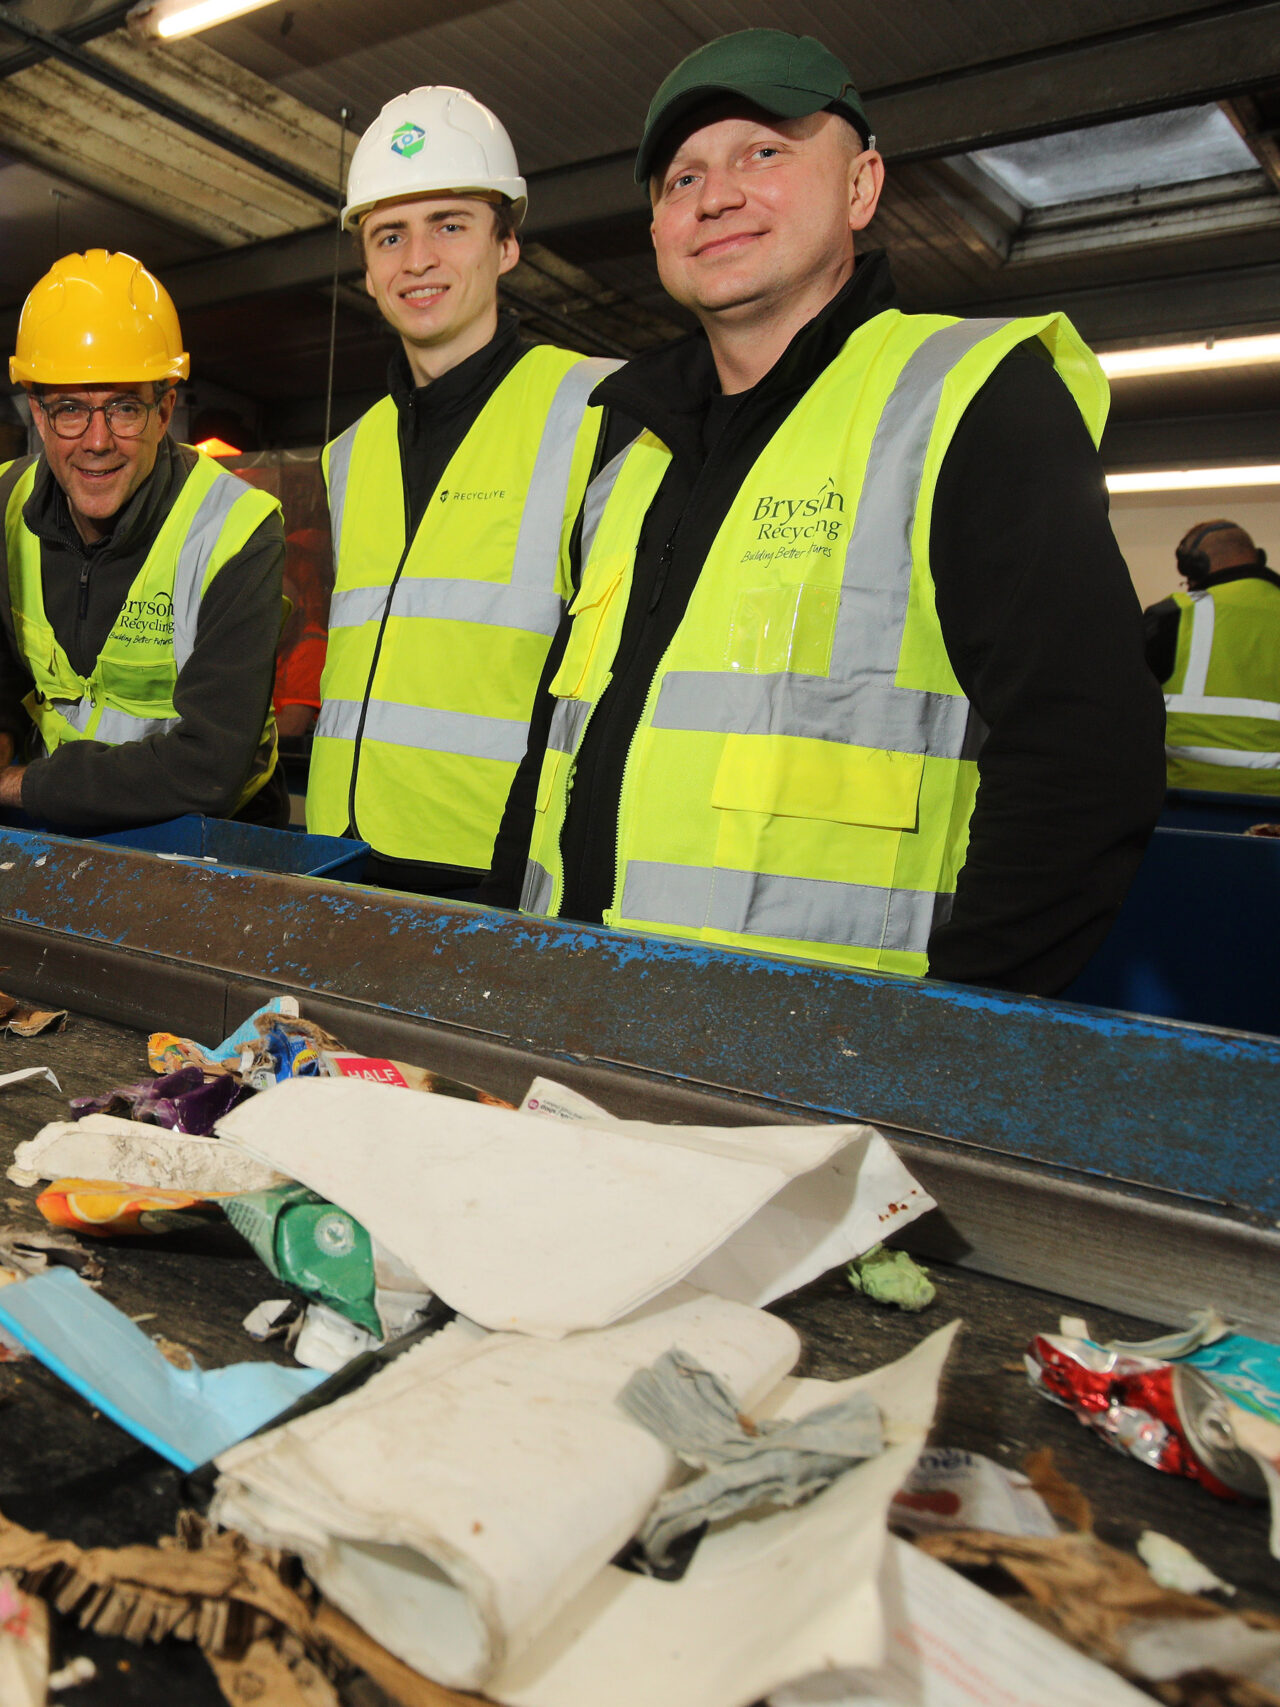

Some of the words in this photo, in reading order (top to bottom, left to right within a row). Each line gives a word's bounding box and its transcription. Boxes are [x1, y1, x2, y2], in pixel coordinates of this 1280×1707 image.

[752, 490, 845, 527] Brysn
[740, 550, 775, 568] Building
[775, 546, 807, 559] Better
[120, 615, 175, 635] Recycling
[347, 1068, 396, 1082] HALF
